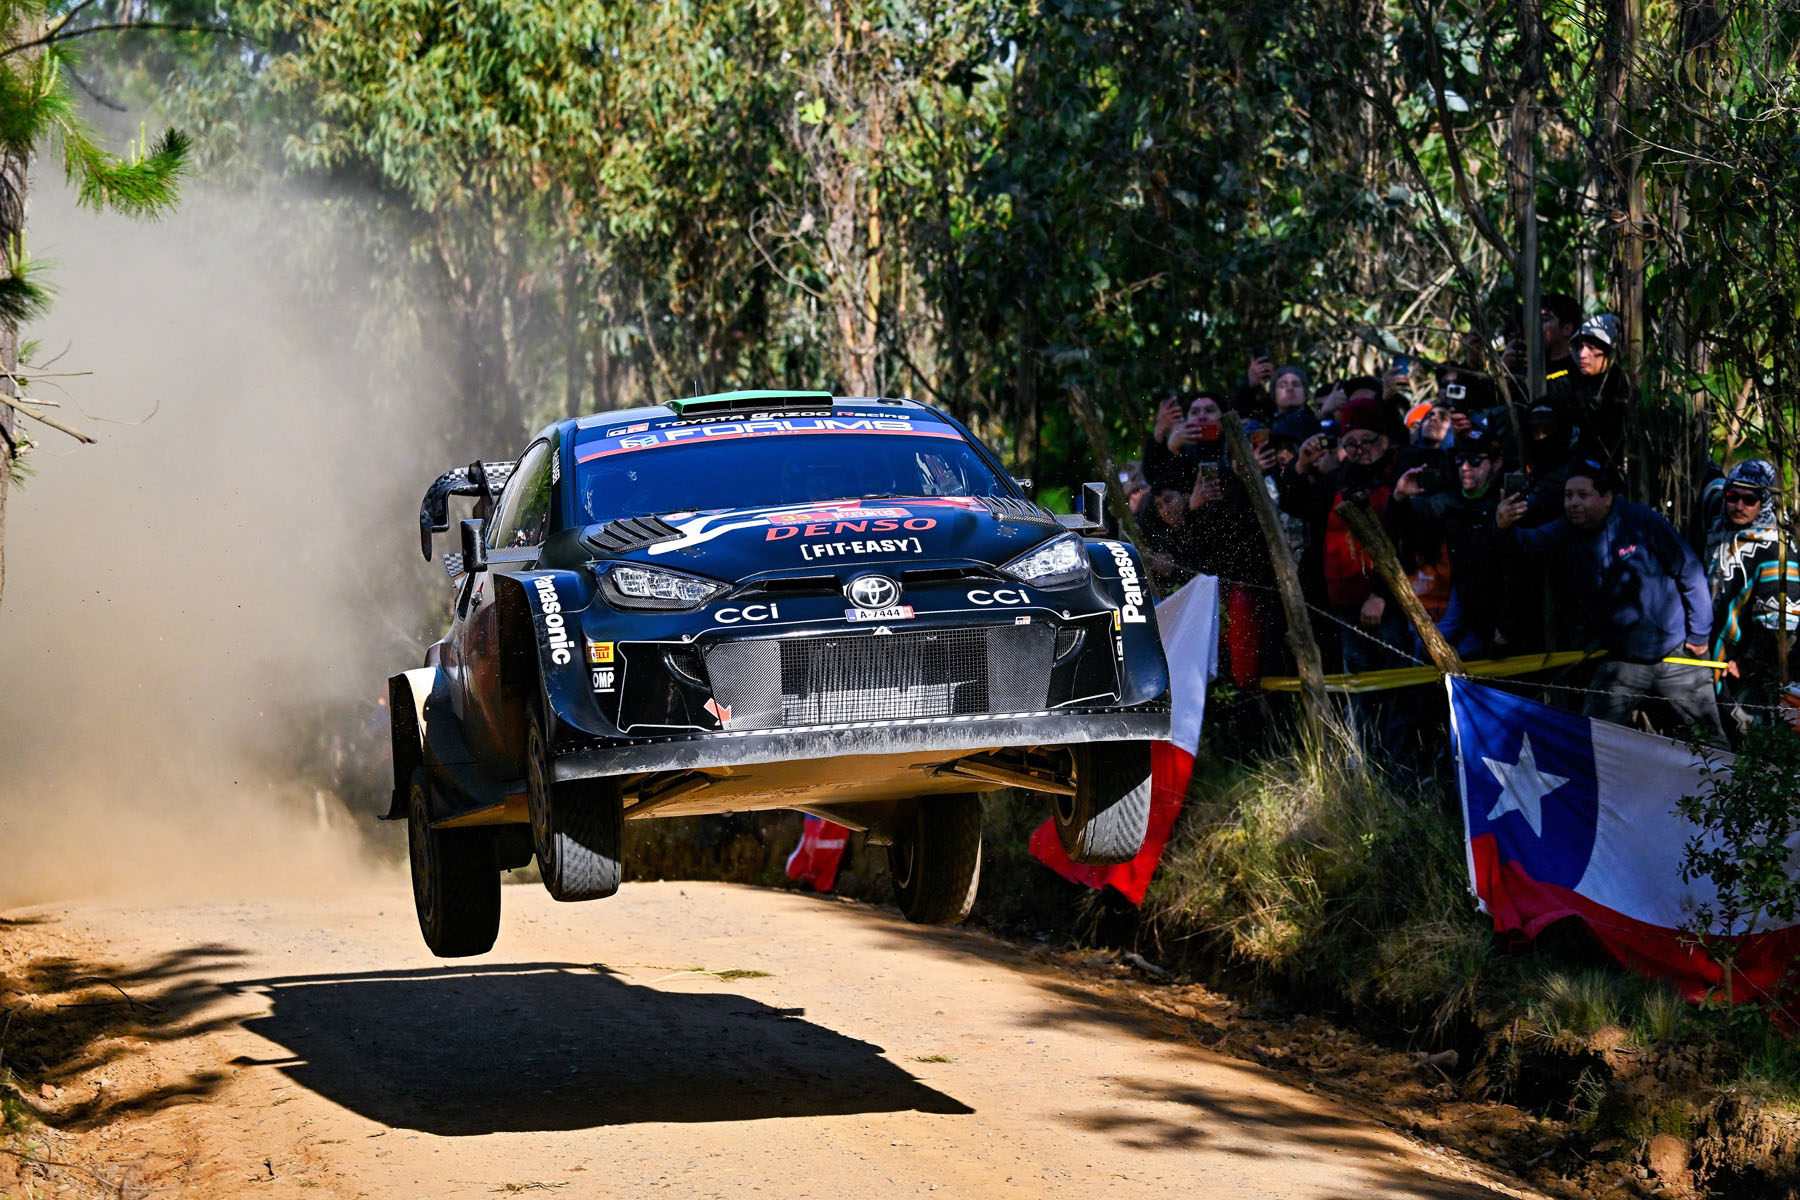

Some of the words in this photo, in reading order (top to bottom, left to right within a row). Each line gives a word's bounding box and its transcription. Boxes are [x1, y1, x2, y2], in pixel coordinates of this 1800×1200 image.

[655, 414, 745, 428] TOYOTA
[750, 411, 831, 421] GAZOO
[664, 419, 914, 441] FORUM8
[765, 518, 938, 542] DENSO
[860, 608, 901, 619] A-7444
[592, 671, 615, 689] OMP
